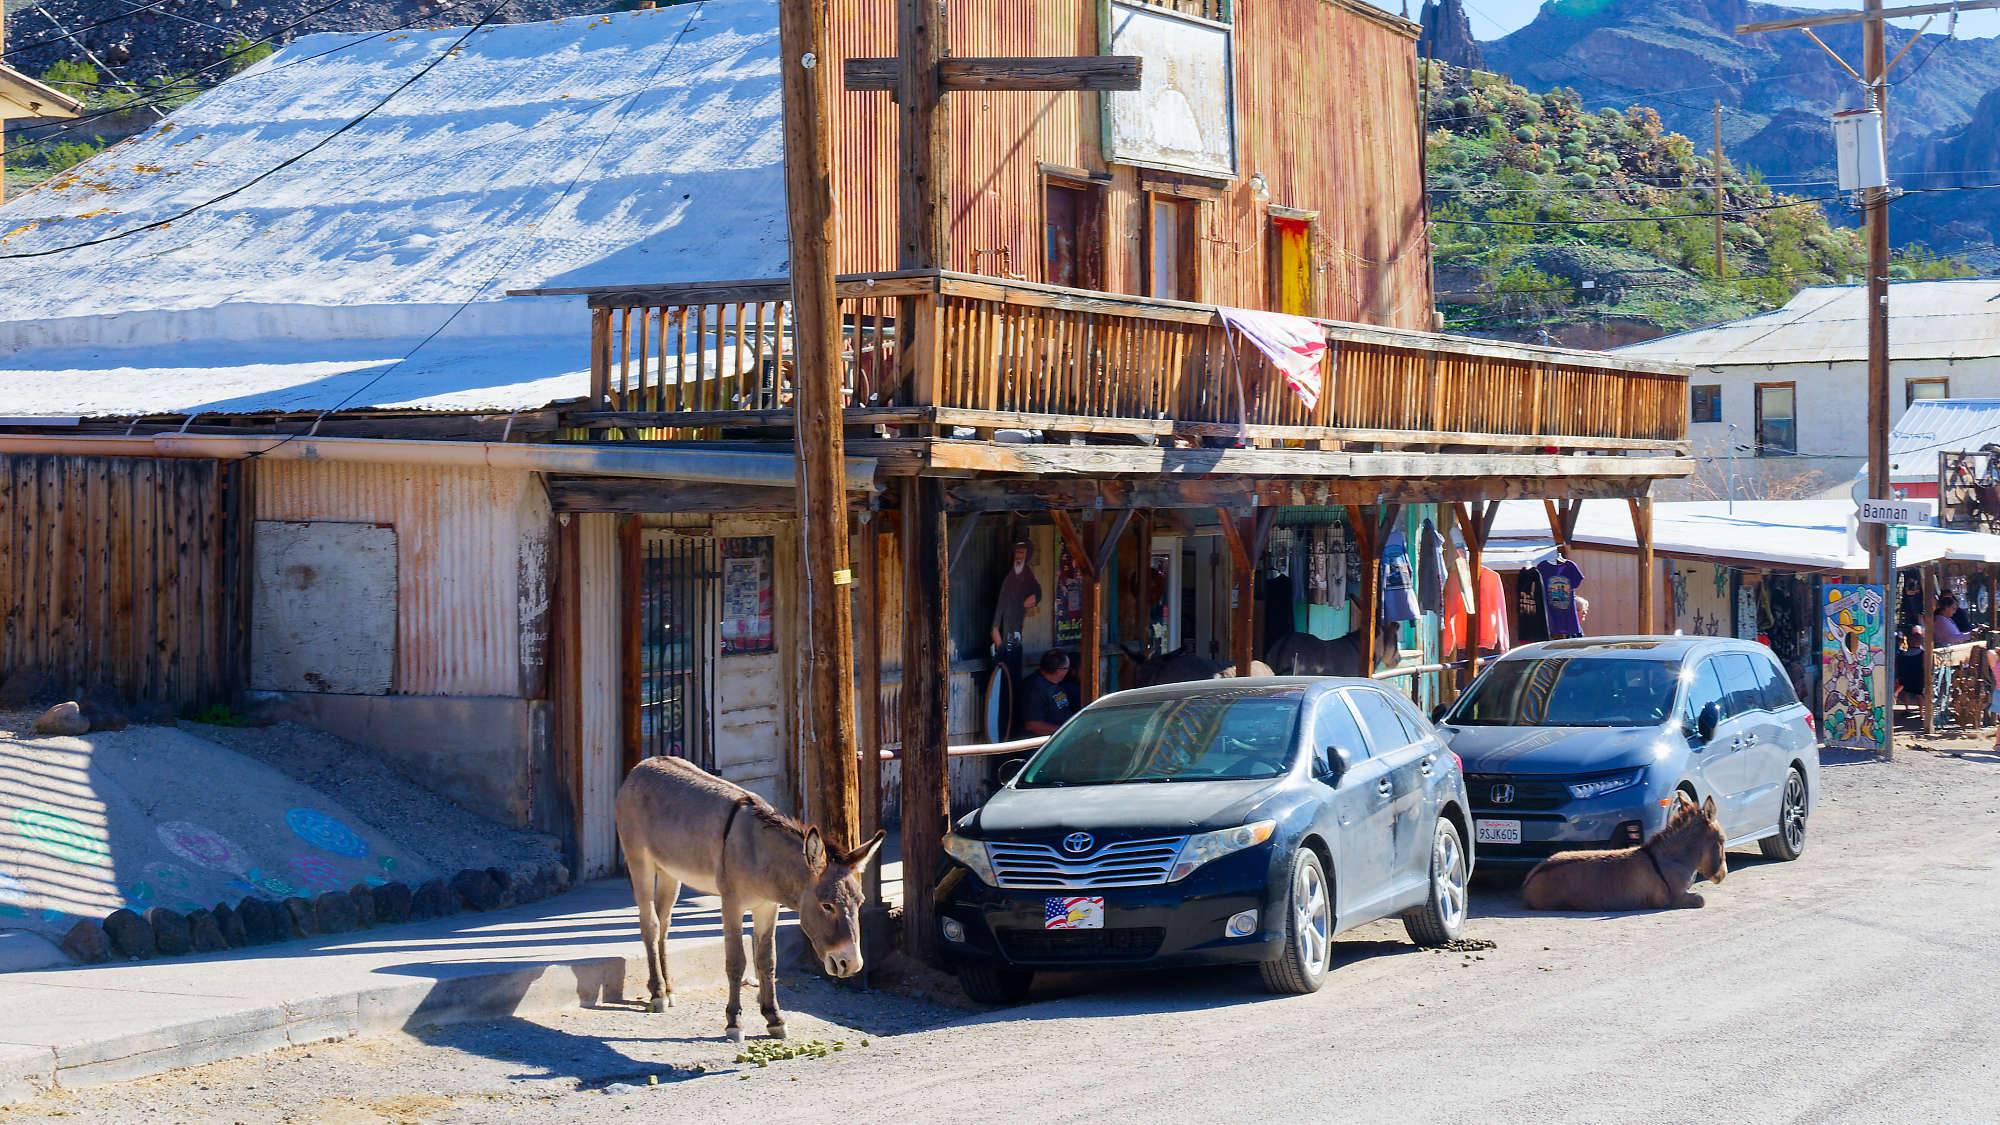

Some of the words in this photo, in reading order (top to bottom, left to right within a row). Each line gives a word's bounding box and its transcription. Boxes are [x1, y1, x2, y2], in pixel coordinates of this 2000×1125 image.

[1863, 503, 1908, 520] Bannan
[1919, 511, 1929, 521] Ln
[1862, 598, 1878, 613] 66
